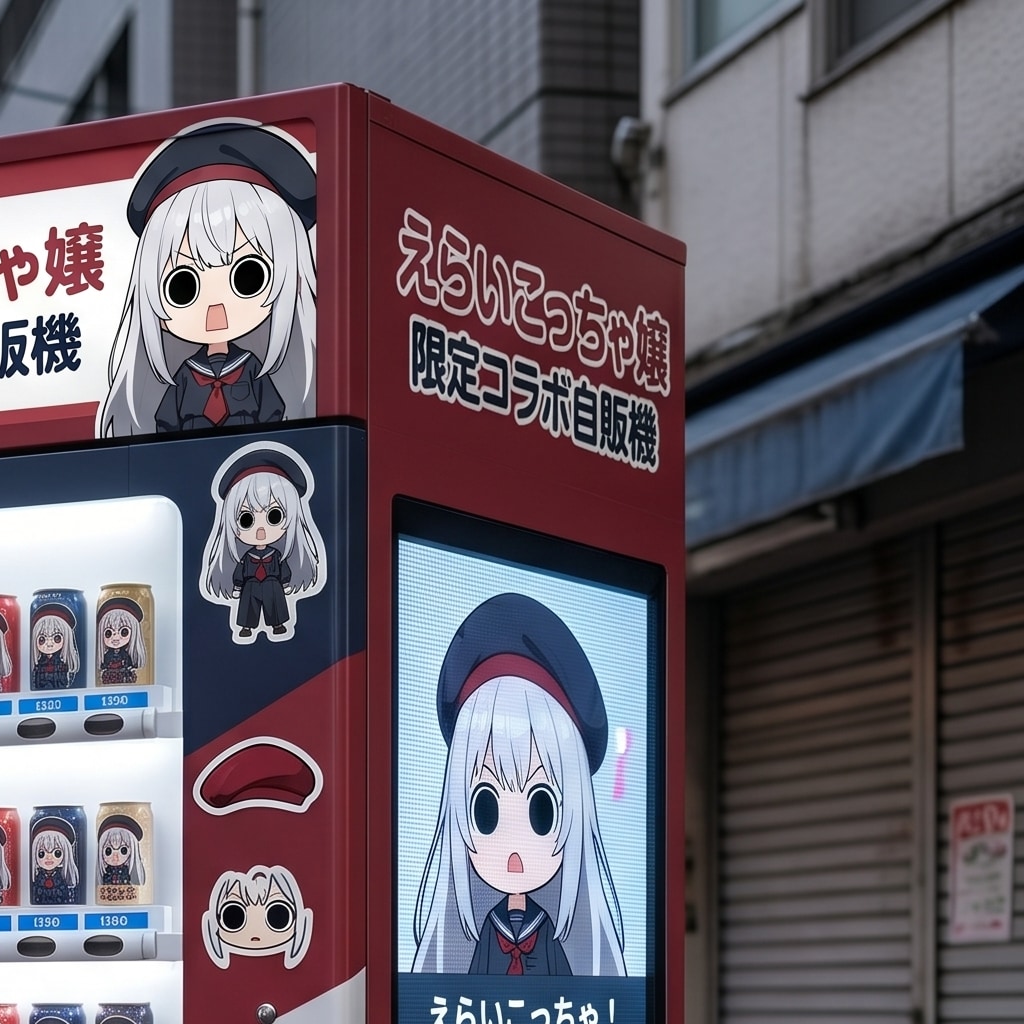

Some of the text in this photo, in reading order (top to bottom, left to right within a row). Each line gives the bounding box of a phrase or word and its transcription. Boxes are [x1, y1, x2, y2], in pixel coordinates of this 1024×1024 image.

[396, 207, 670, 397] えらいこっちゃ嬢
[410, 315, 658, 472] 限定コラボ自販機
